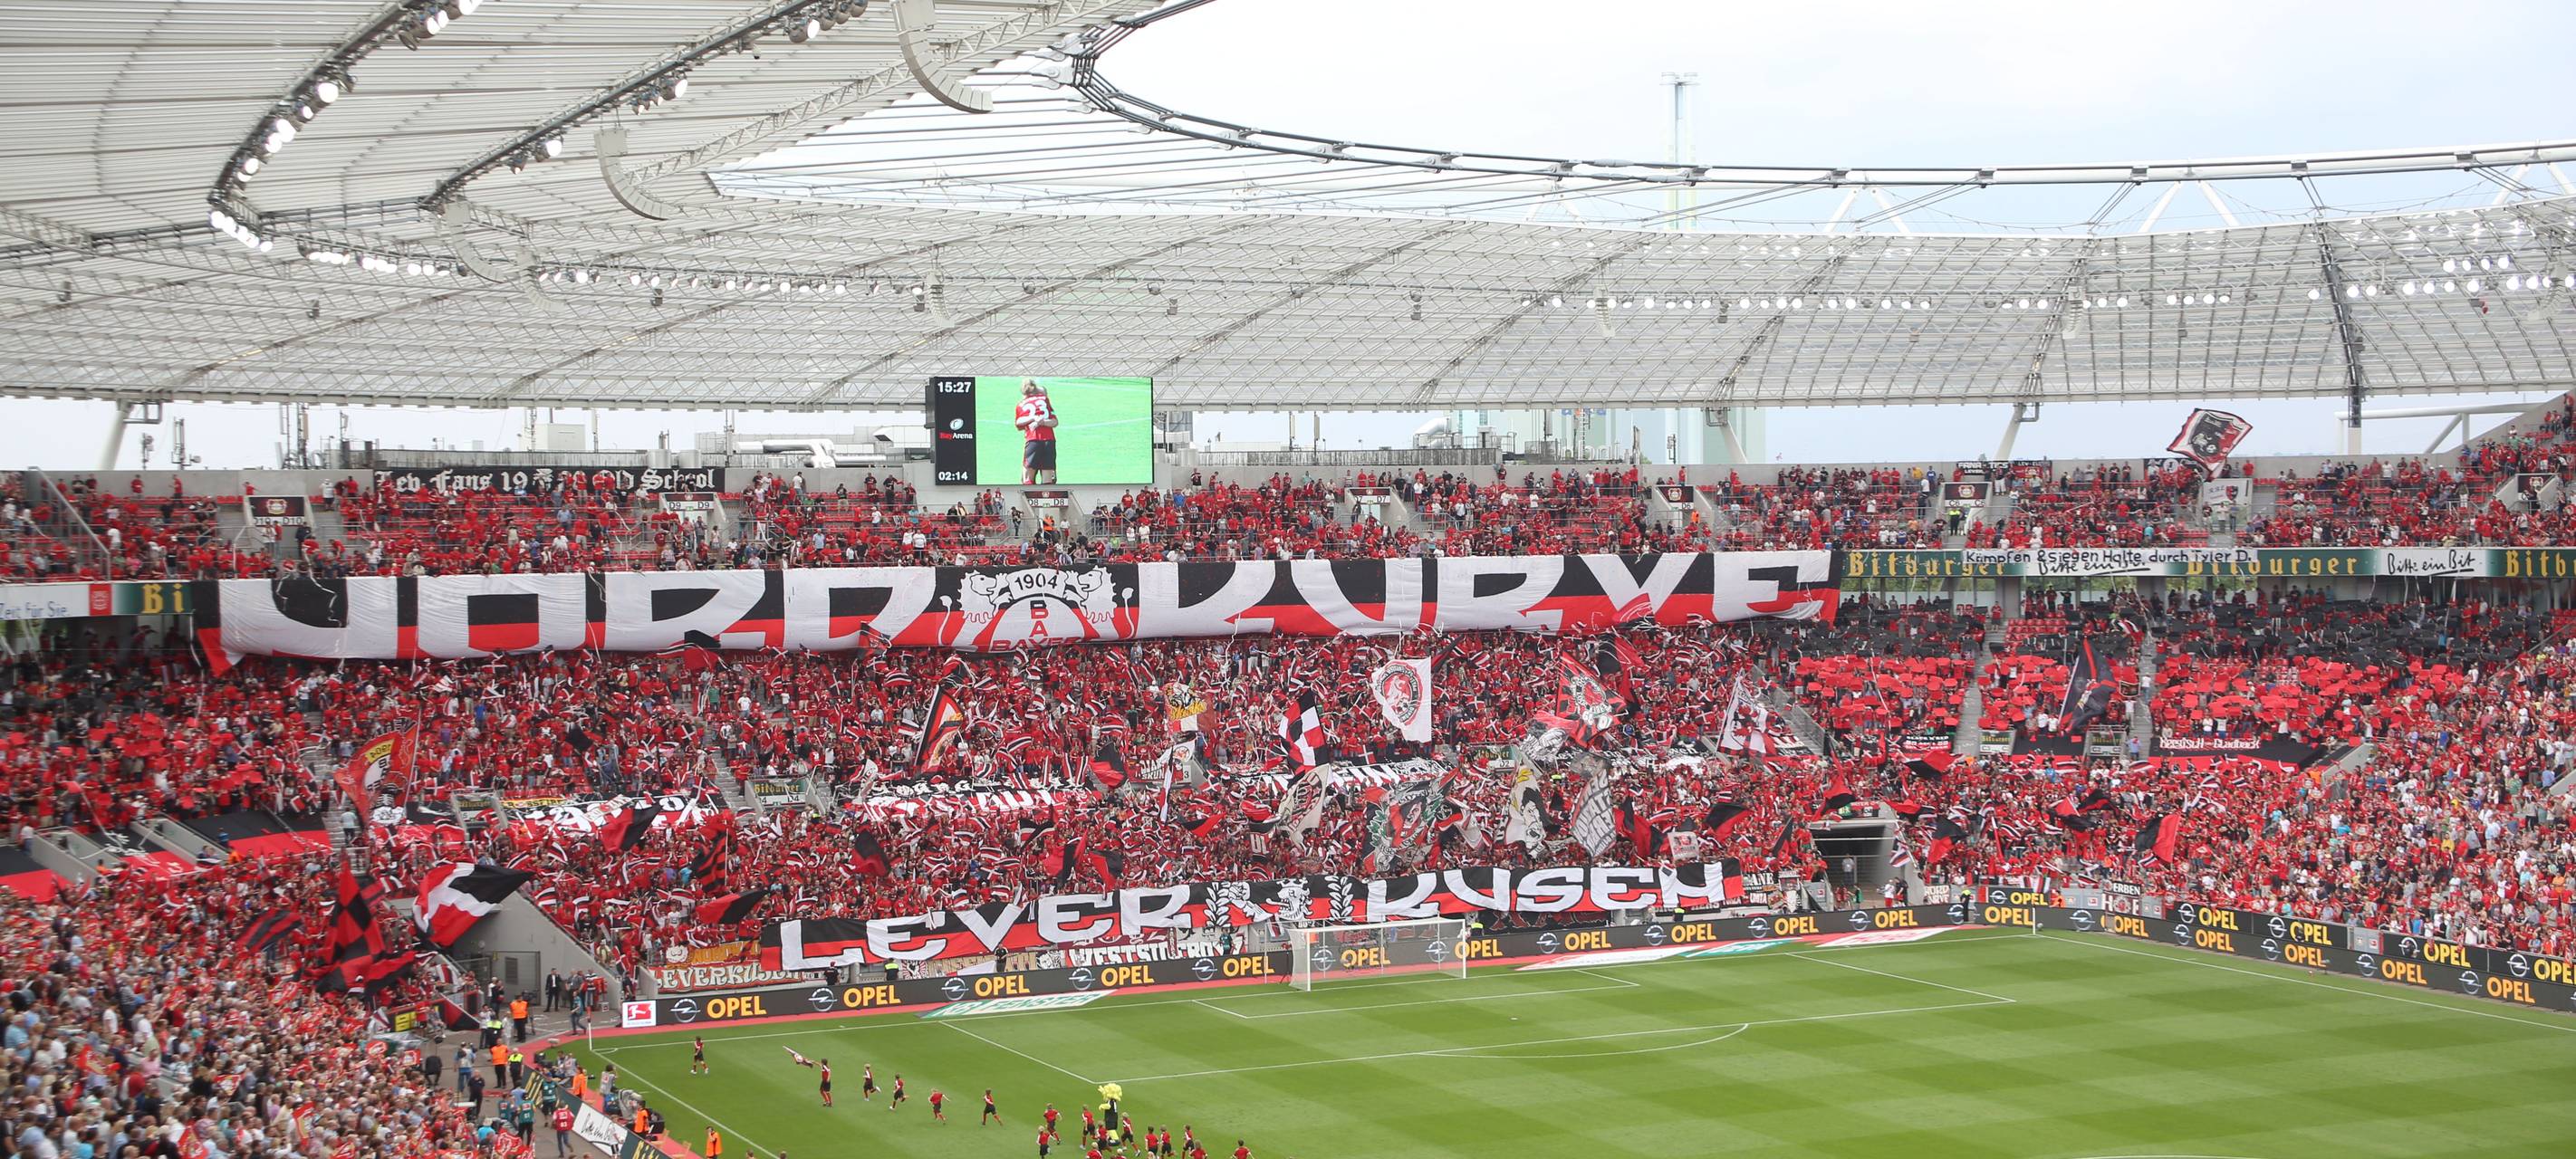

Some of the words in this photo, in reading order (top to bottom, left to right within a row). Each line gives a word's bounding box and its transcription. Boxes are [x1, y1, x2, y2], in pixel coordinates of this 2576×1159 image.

[937, 381, 972, 394] 15:27
[938, 471, 968, 482] 02:14
[2148, 550, 2189, 563] durch
[2192, 550, 2232, 563] Tyler
[2422, 557, 2446, 570] ein
[2448, 549, 2476, 570] Bit
[2505, 549, 2576, 578] Bitb
[1014, 571, 1059, 591] 1904
[2010, 891, 2049, 906] OPEL
[1774, 916, 1820, 936] OPEL
[1875, 909, 1918, 928] OPEL
[1985, 905, 2034, 926] OPEL
[2114, 915, 2149, 938] OPEL
[2198, 906, 2239, 931] OPEL
[780, 885, 1193, 972] LEVER
[1671, 923, 1717, 943] OPEL
[1455, 938, 1504, 959] OPEL
[1564, 930, 1611, 951] OPEL
[2195, 928, 2235, 953] OPEL
[1341, 946, 1391, 967] OPEL
[2284, 943, 2328, 968] OPEL
[2424, 941, 2472, 968] OPEL
[1101, 964, 1155, 987] OPEL
[1223, 955, 1275, 977] OPEL
[2381, 959, 2427, 985] OPEL
[843, 984, 901, 1008] OPEL
[975, 974, 1031, 997] OPEL
[2486, 976, 2536, 1004] OPEL
[706, 995, 767, 1020] OPEL
